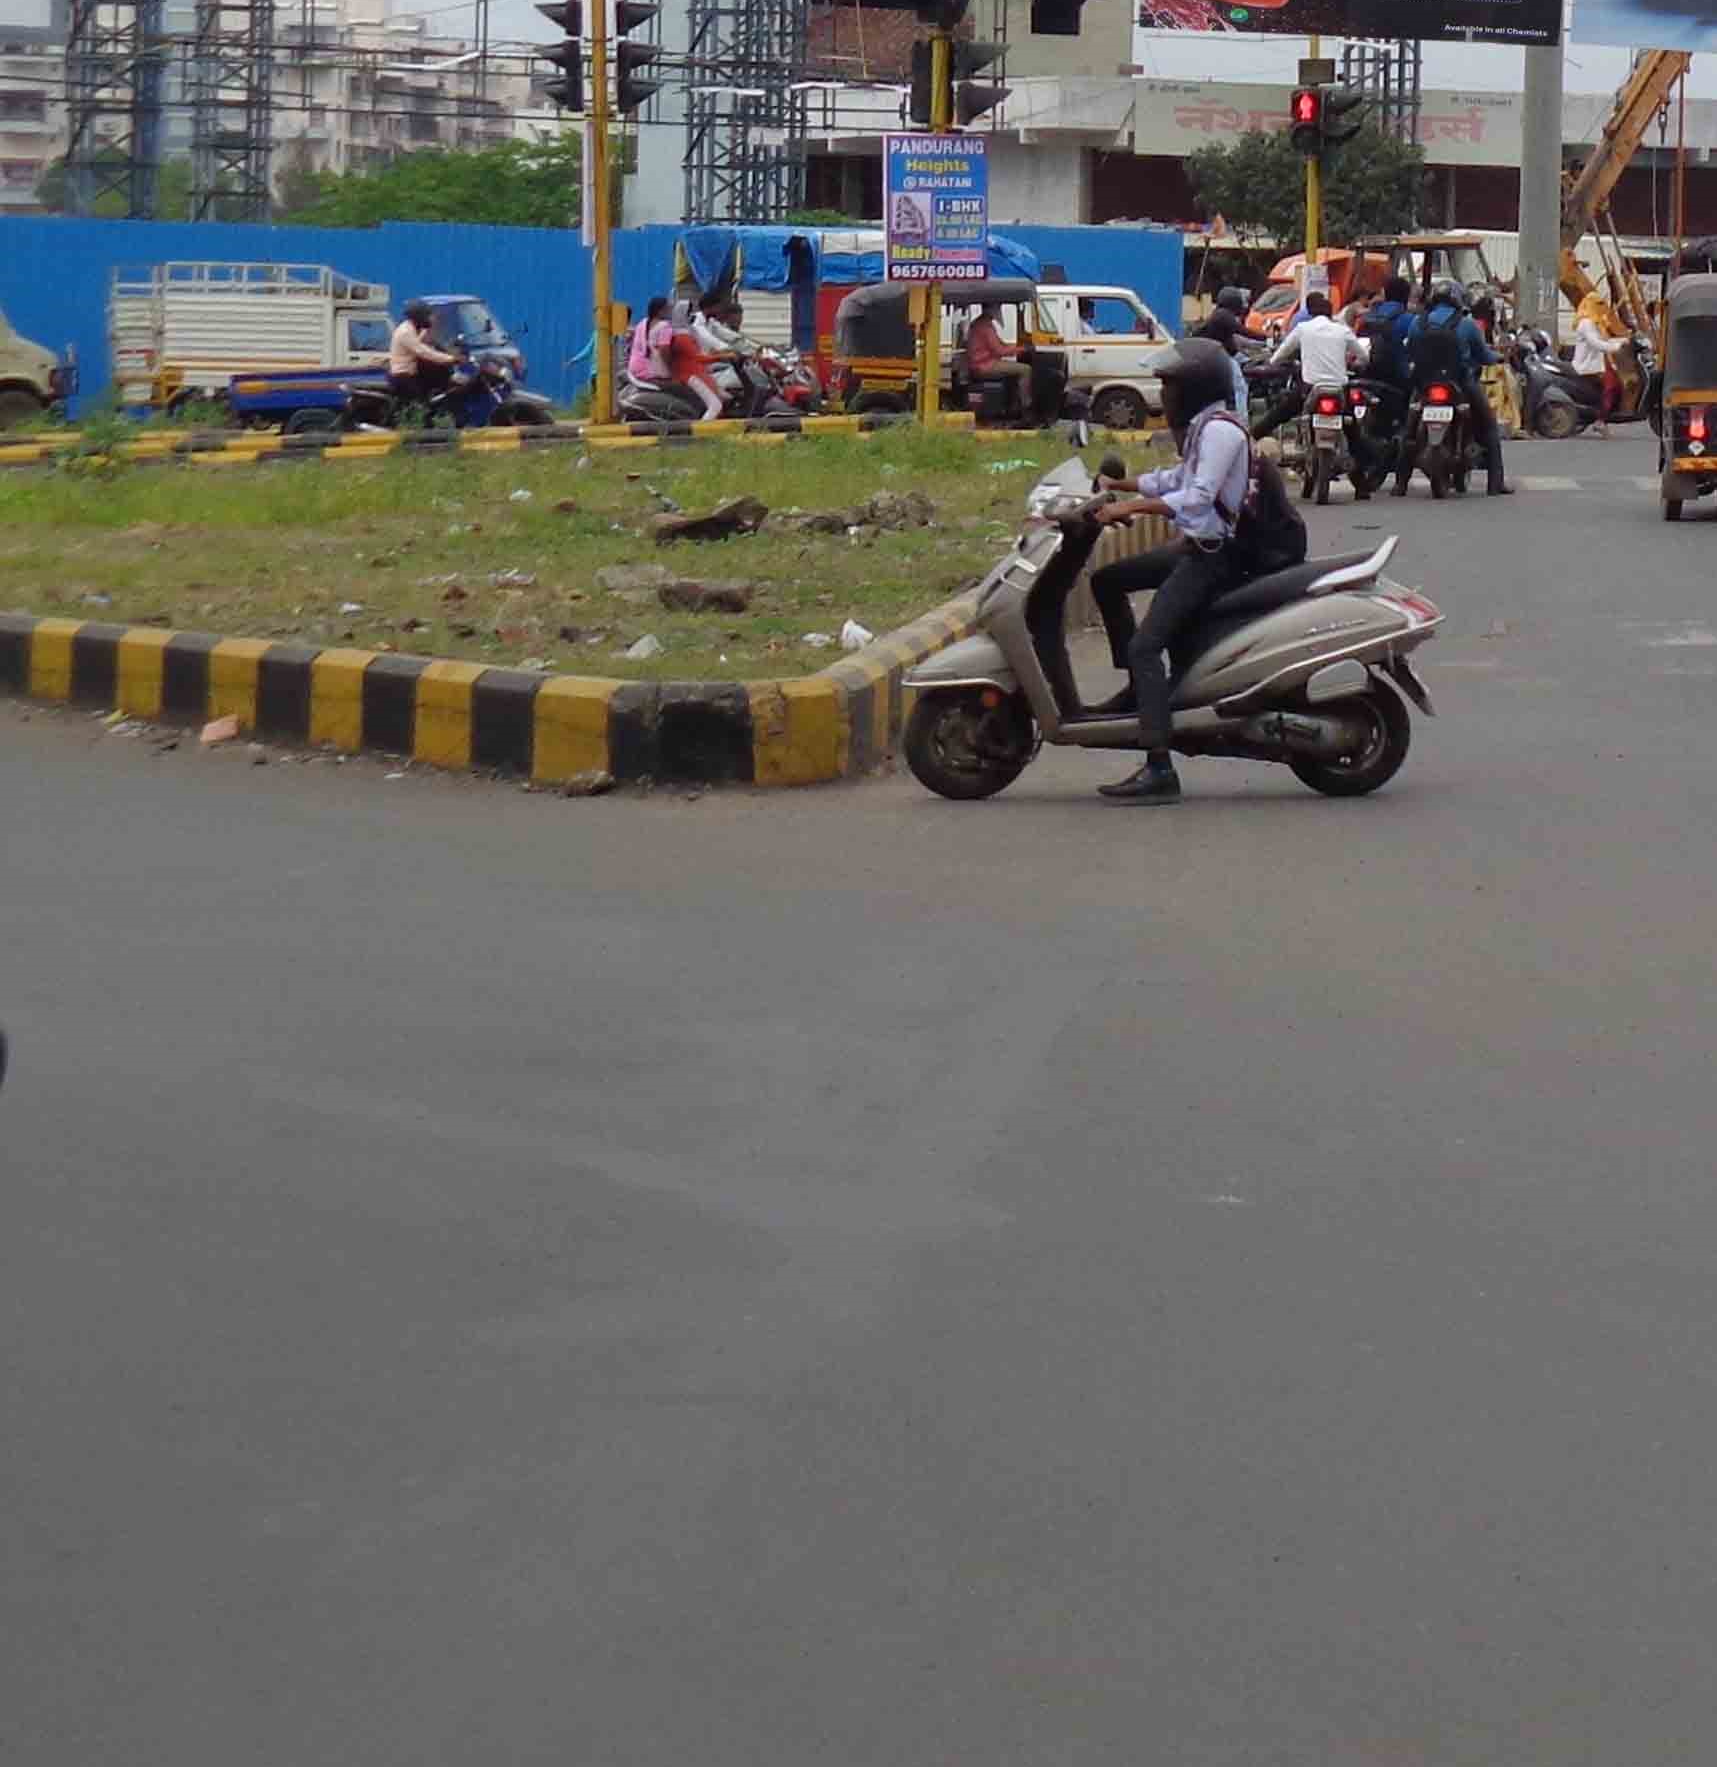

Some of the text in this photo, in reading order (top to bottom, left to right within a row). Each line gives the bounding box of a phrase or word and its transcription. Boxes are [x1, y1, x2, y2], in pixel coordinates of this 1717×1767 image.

[889, 139, 985, 155] PANDURANG
[905, 158, 970, 174] Heights
[892, 244, 931, 261] Ready
